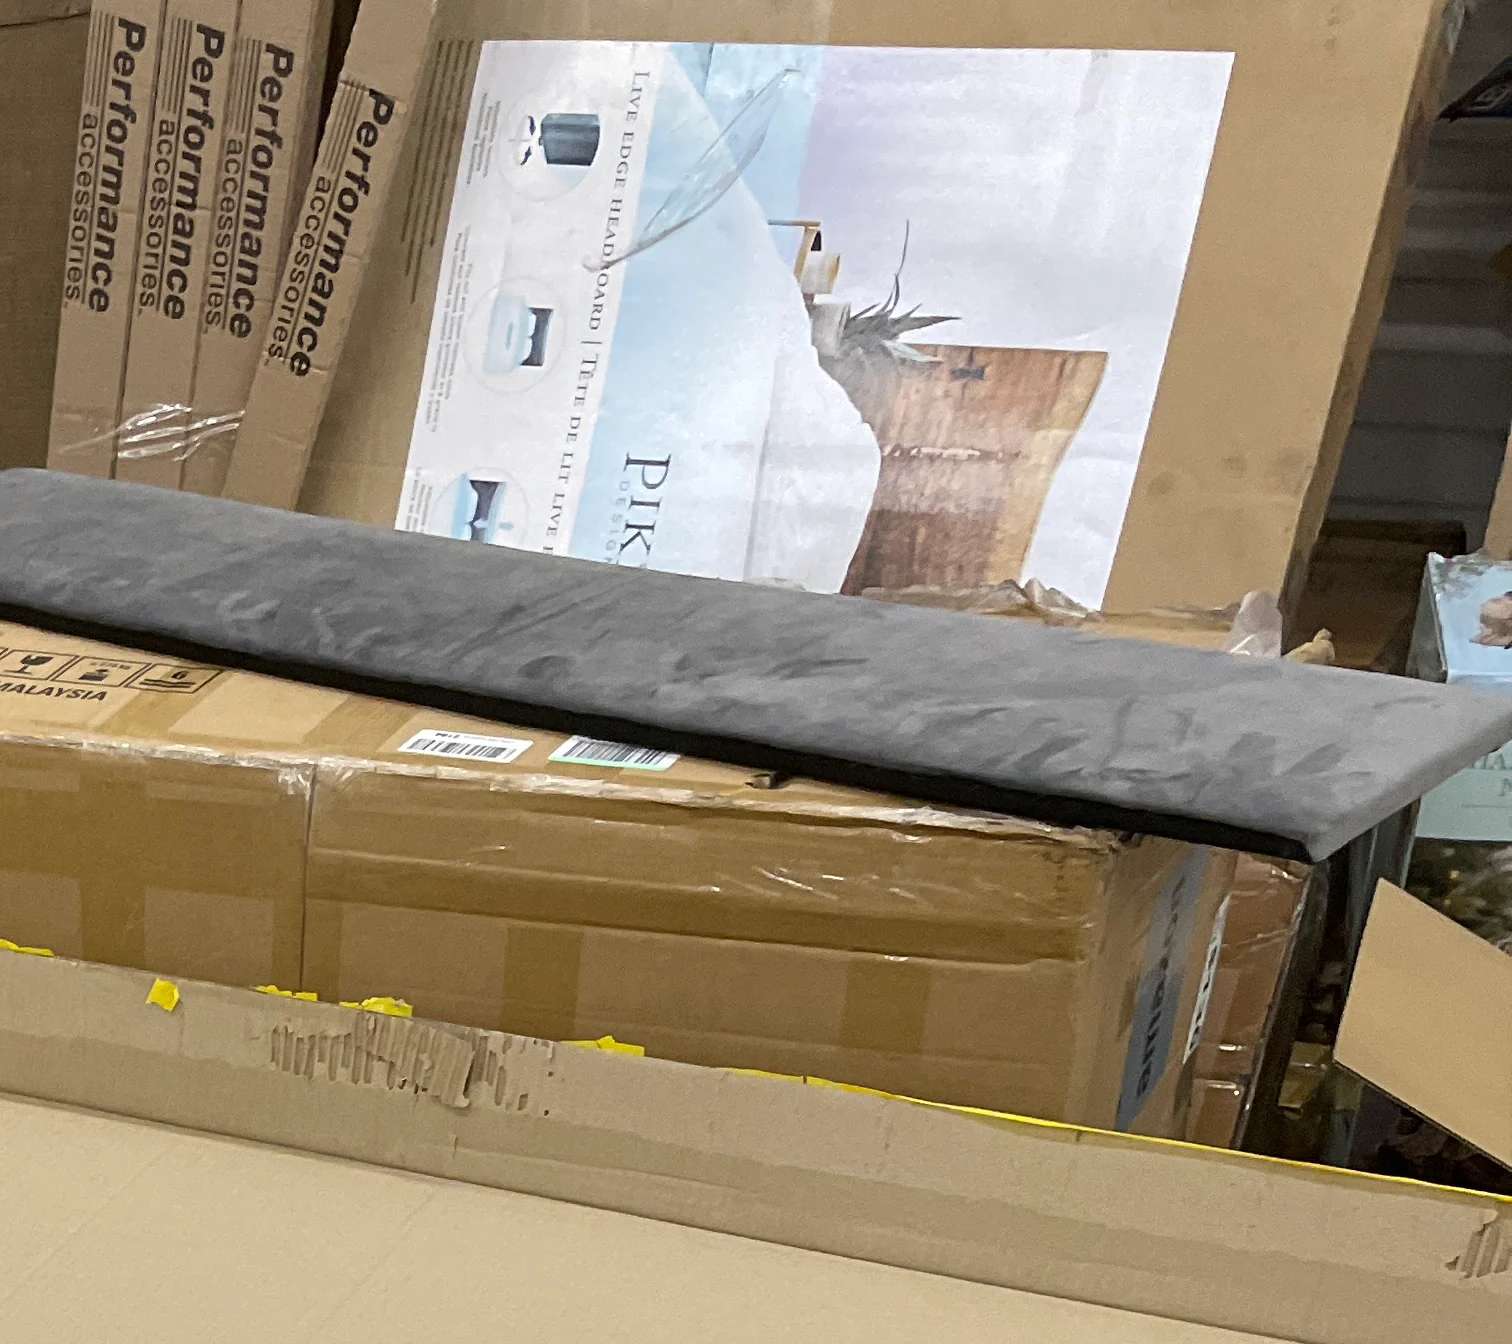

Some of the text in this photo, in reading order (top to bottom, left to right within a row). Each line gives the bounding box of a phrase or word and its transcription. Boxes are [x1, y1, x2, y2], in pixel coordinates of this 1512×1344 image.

[89, 16, 146, 313] Performance
[163, 23, 225, 320] Performance
[229, 43, 295, 339] Performance
[614, 132, 634, 188] EDGE
[291, 88, 395, 377] Performance
[589, 199, 623, 331] HEADOARD
[558, 452, 574, 485] LIT
[566, 416, 581, 442] DE
[546, 493, 565, 537] LIVE
[616, 452, 671, 567] PIK
